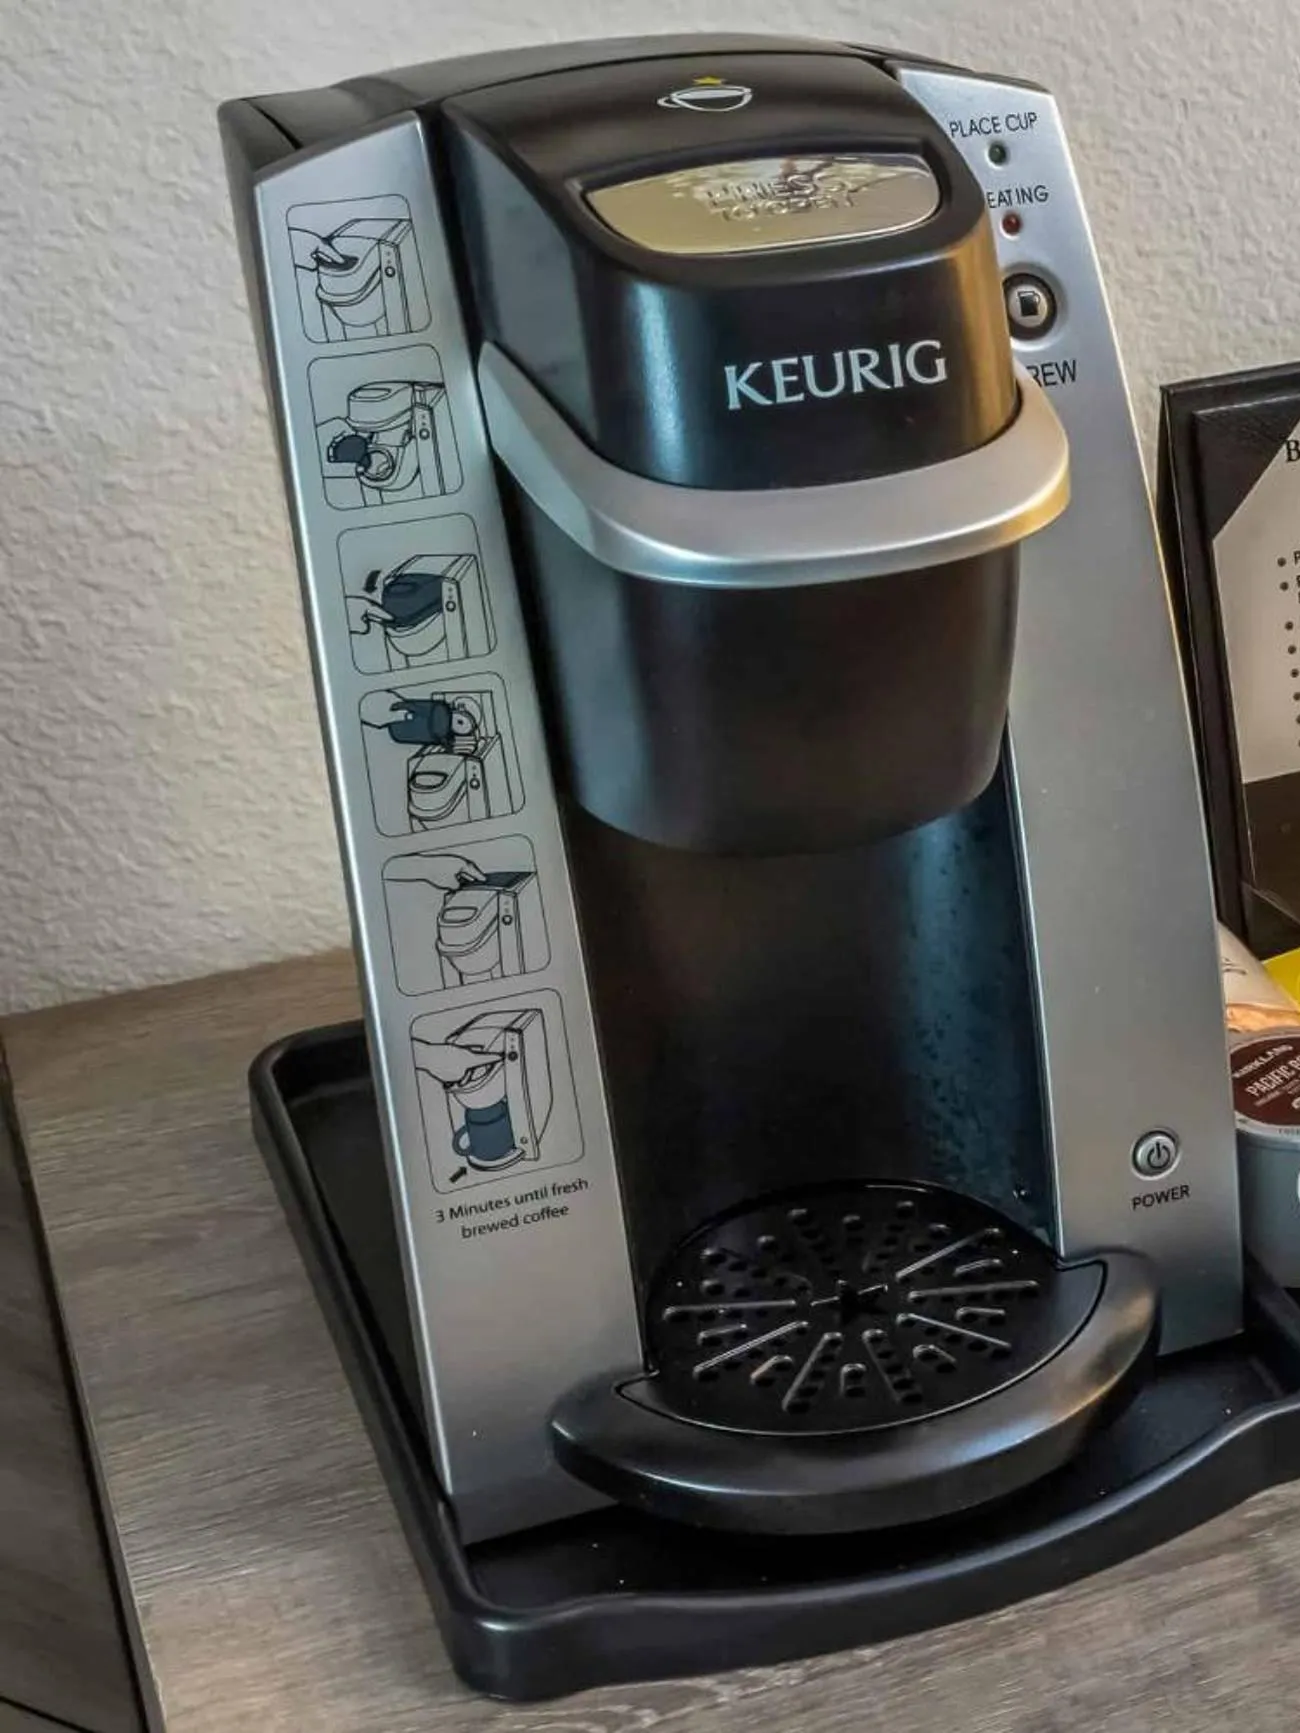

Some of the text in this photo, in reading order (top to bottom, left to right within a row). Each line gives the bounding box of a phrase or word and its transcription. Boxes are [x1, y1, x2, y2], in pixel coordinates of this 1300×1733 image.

[948, 112, 1038, 139] PLACE CUP
[986, 185, 1049, 209] EATING
[723, 339, 949, 411] KEURIG
[1025, 359, 1077, 388] REW
[1245, 1064, 1296, 1097] PACIFIC
[435, 1178, 589, 1223] 3 Minutes until fresh
[1131, 1185, 1190, 1211] POWER
[461, 1204, 570, 1239] brewed coffee
